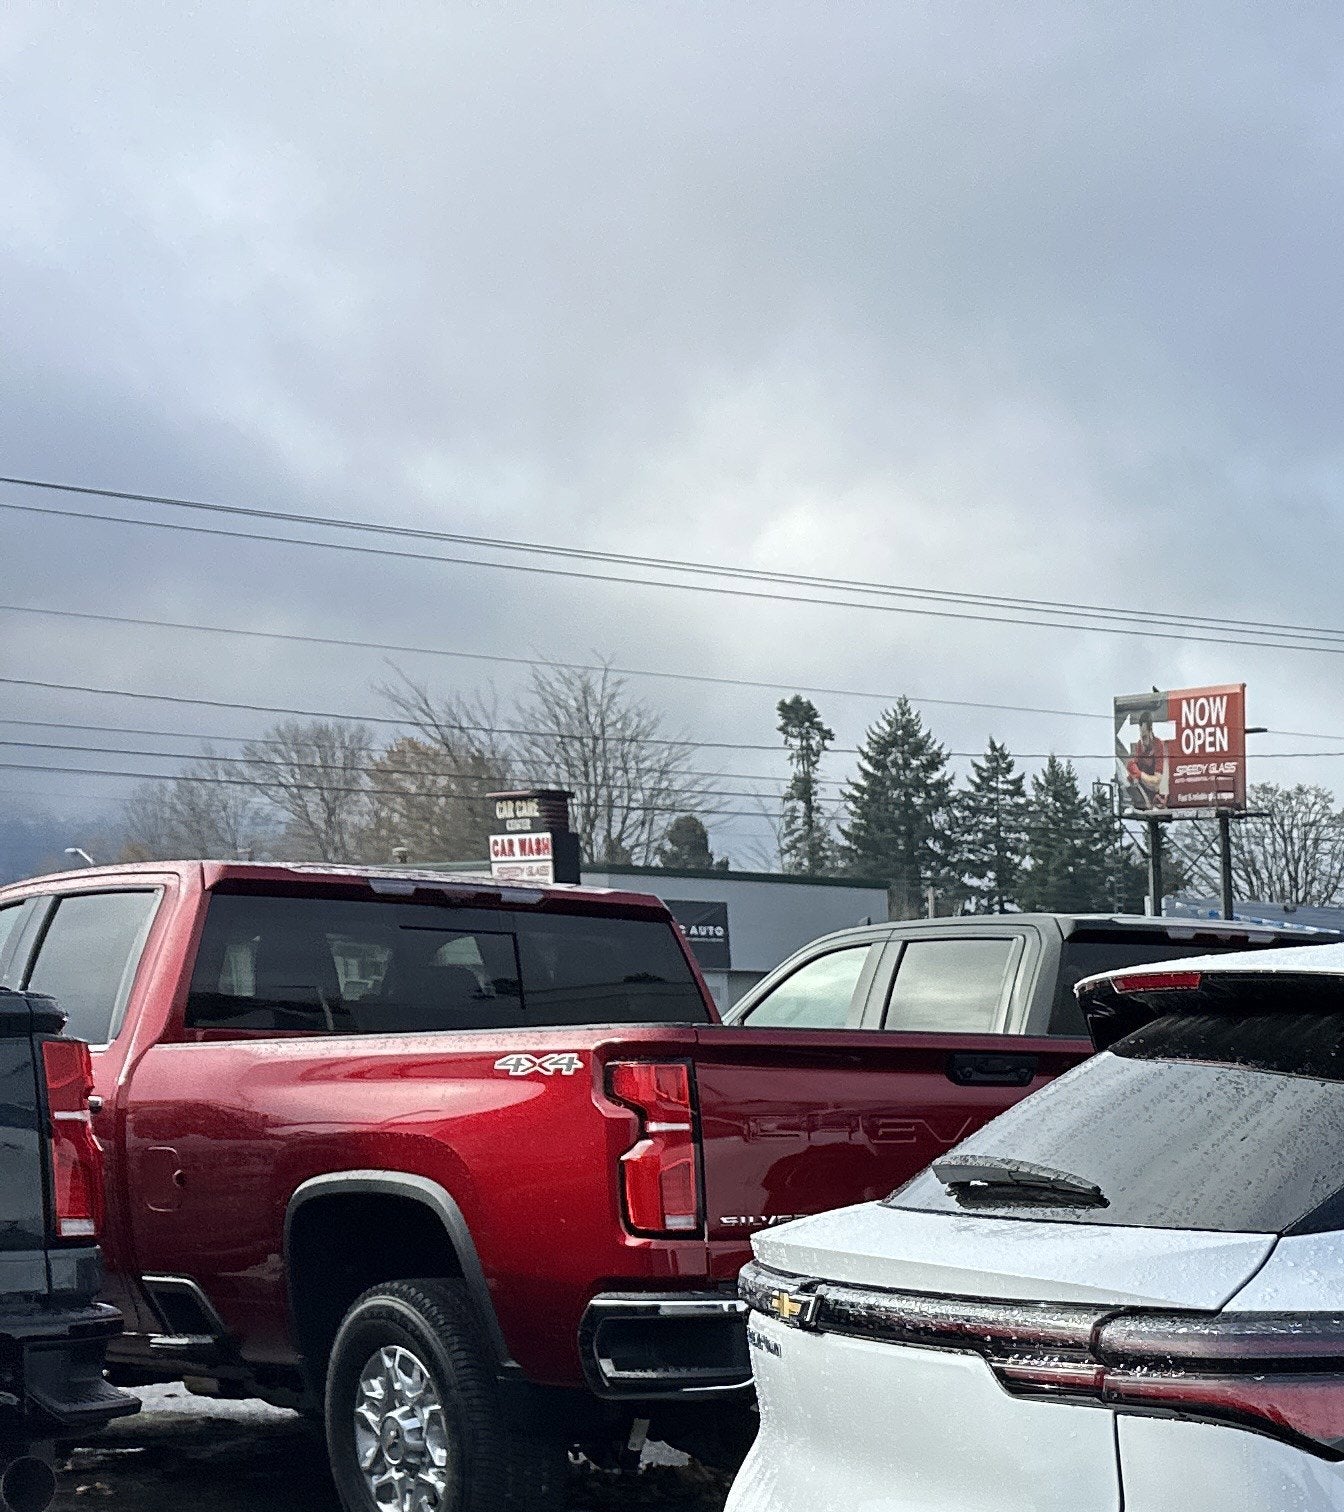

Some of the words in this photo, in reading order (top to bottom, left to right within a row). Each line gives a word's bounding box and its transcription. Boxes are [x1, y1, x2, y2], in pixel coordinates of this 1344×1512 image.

[1181, 696, 1228, 728] NOW
[1181, 726, 1229, 755] OPEN
[492, 838, 516, 857] CAR
[518, 837, 550, 857] WASH
[689, 925, 725, 937] AUTO
[720, 1214, 811, 1227] SILVE
